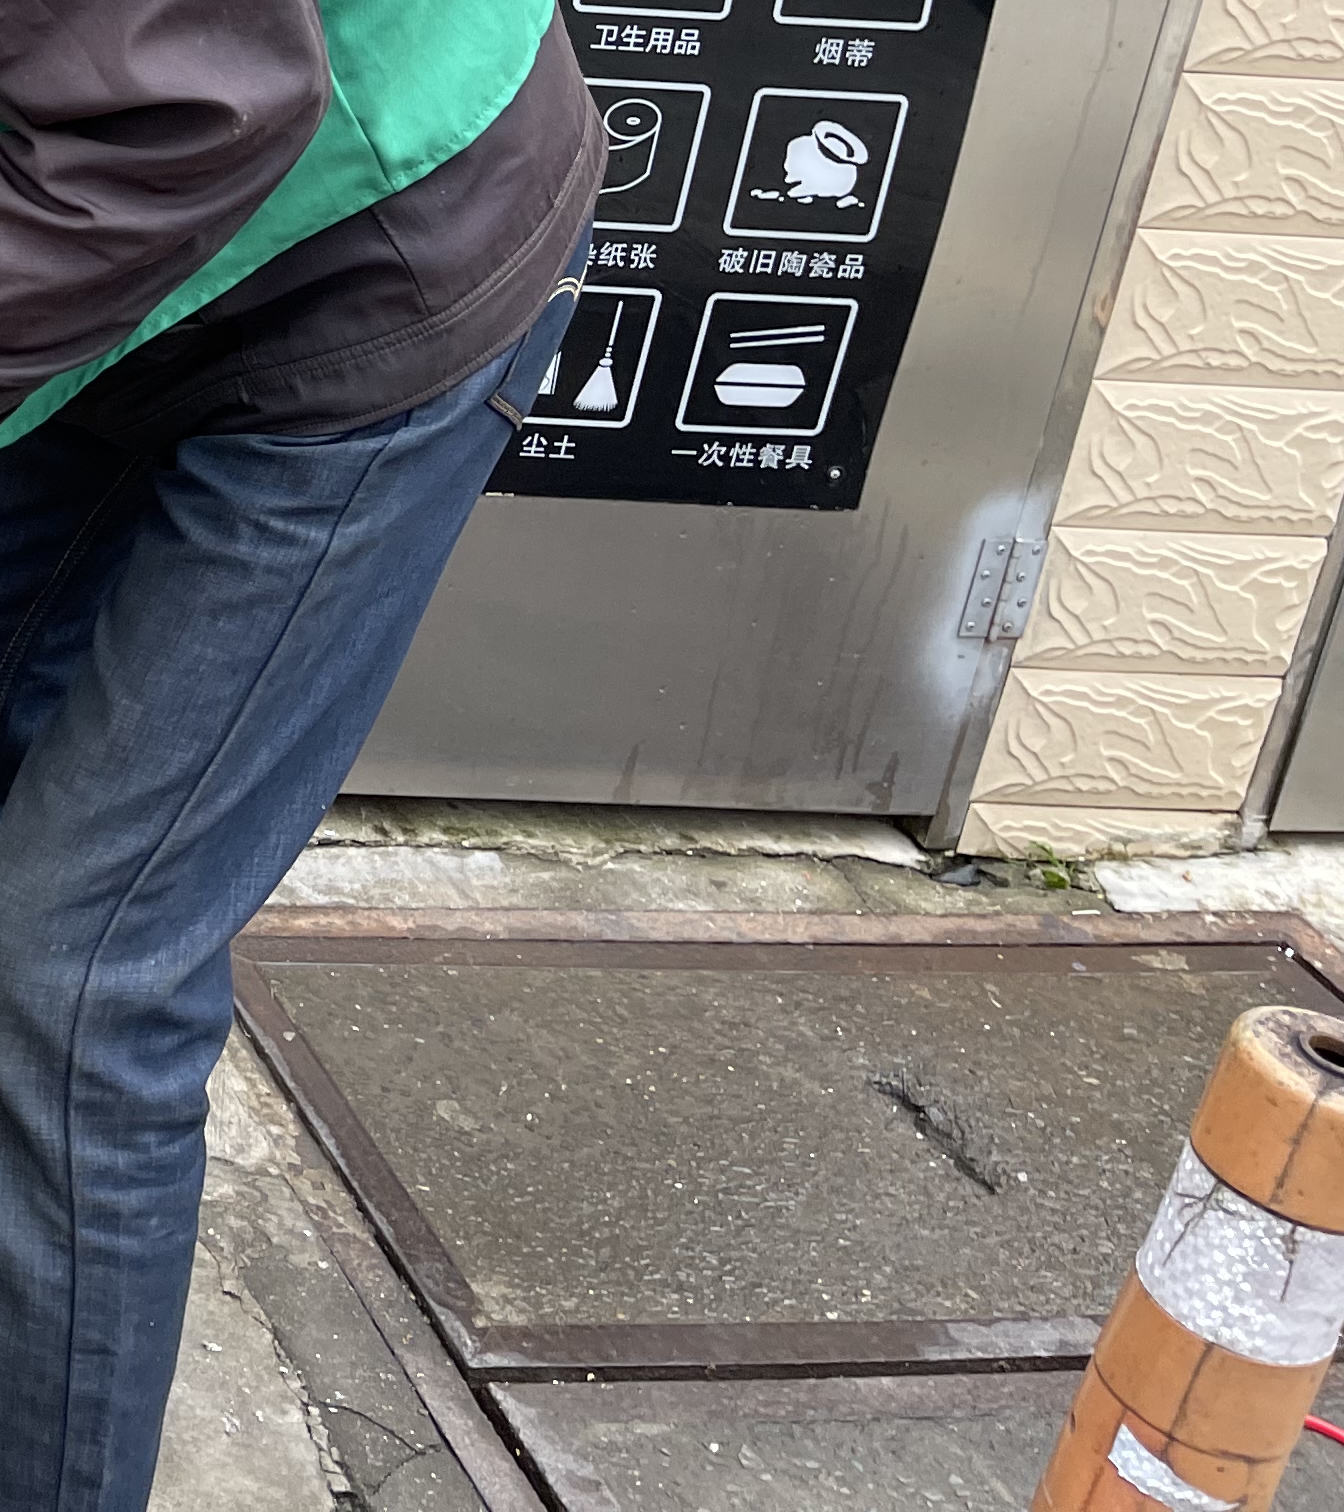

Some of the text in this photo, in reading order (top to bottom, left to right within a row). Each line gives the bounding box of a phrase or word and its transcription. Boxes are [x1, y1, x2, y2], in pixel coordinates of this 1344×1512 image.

[589, 24, 702, 56] 卫生用品
[813, 37, 876, 68] 烟蒂
[718, 247, 865, 280] 破旧陶瓷品
[519, 432, 576, 459] 尘土
[671, 441, 813, 470] 一次性餐具
